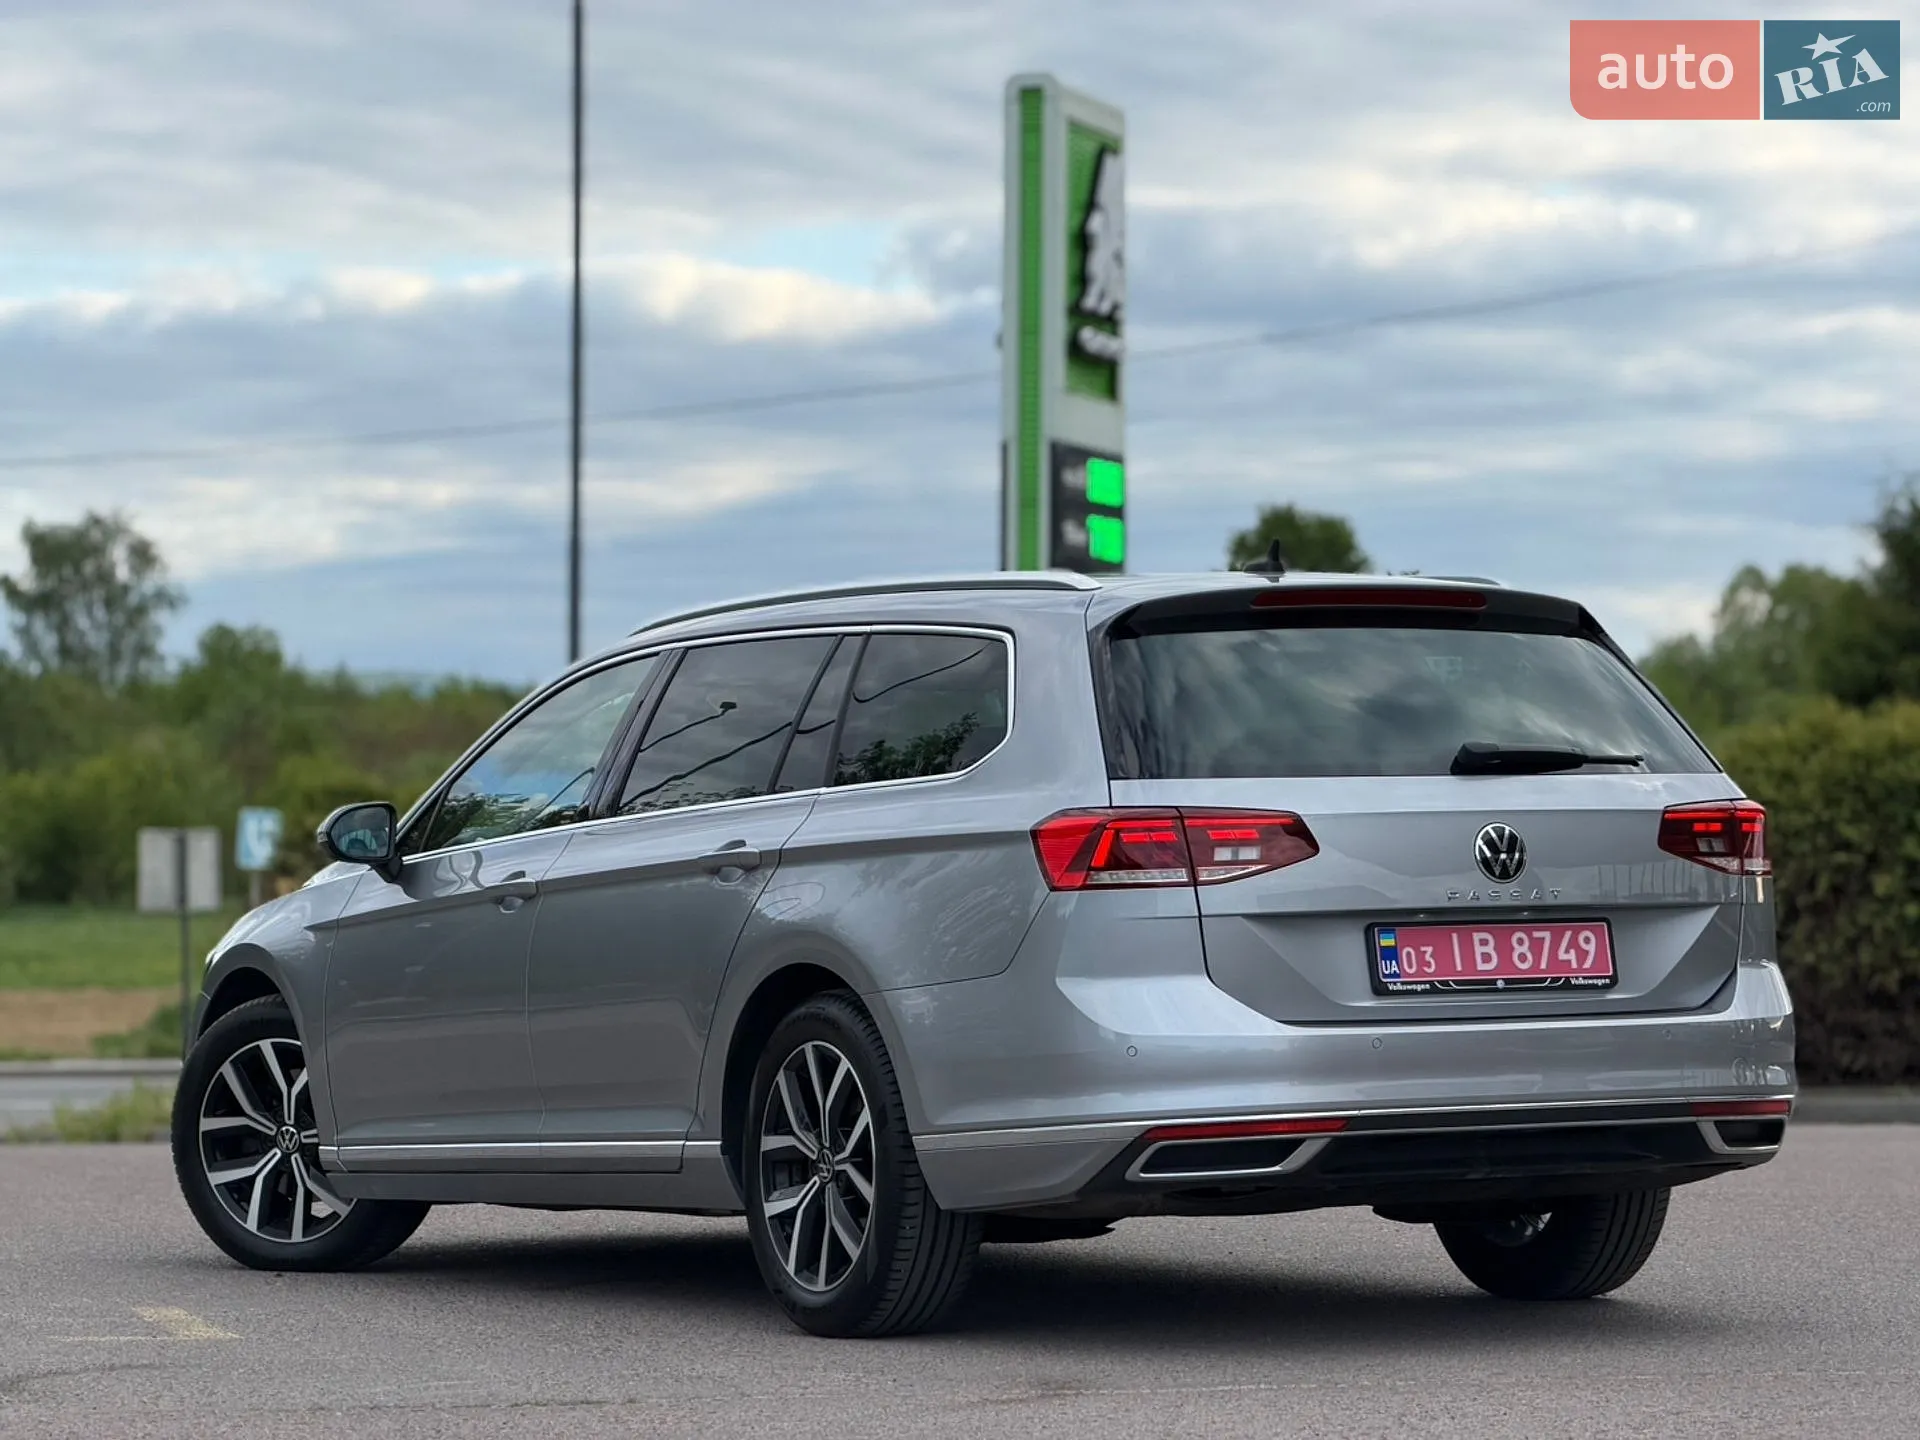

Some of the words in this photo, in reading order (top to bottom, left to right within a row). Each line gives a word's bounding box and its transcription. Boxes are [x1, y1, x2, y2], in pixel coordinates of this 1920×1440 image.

[1446, 887, 1562, 902] PASSAT
[1401, 946, 1437, 974] 03
[1510, 930, 1597, 970] 8749
[1381, 960, 1400, 975] UA
[1386, 982, 1431, 991] Volkswagen
[1569, 976, 1611, 986] Volkswagen
